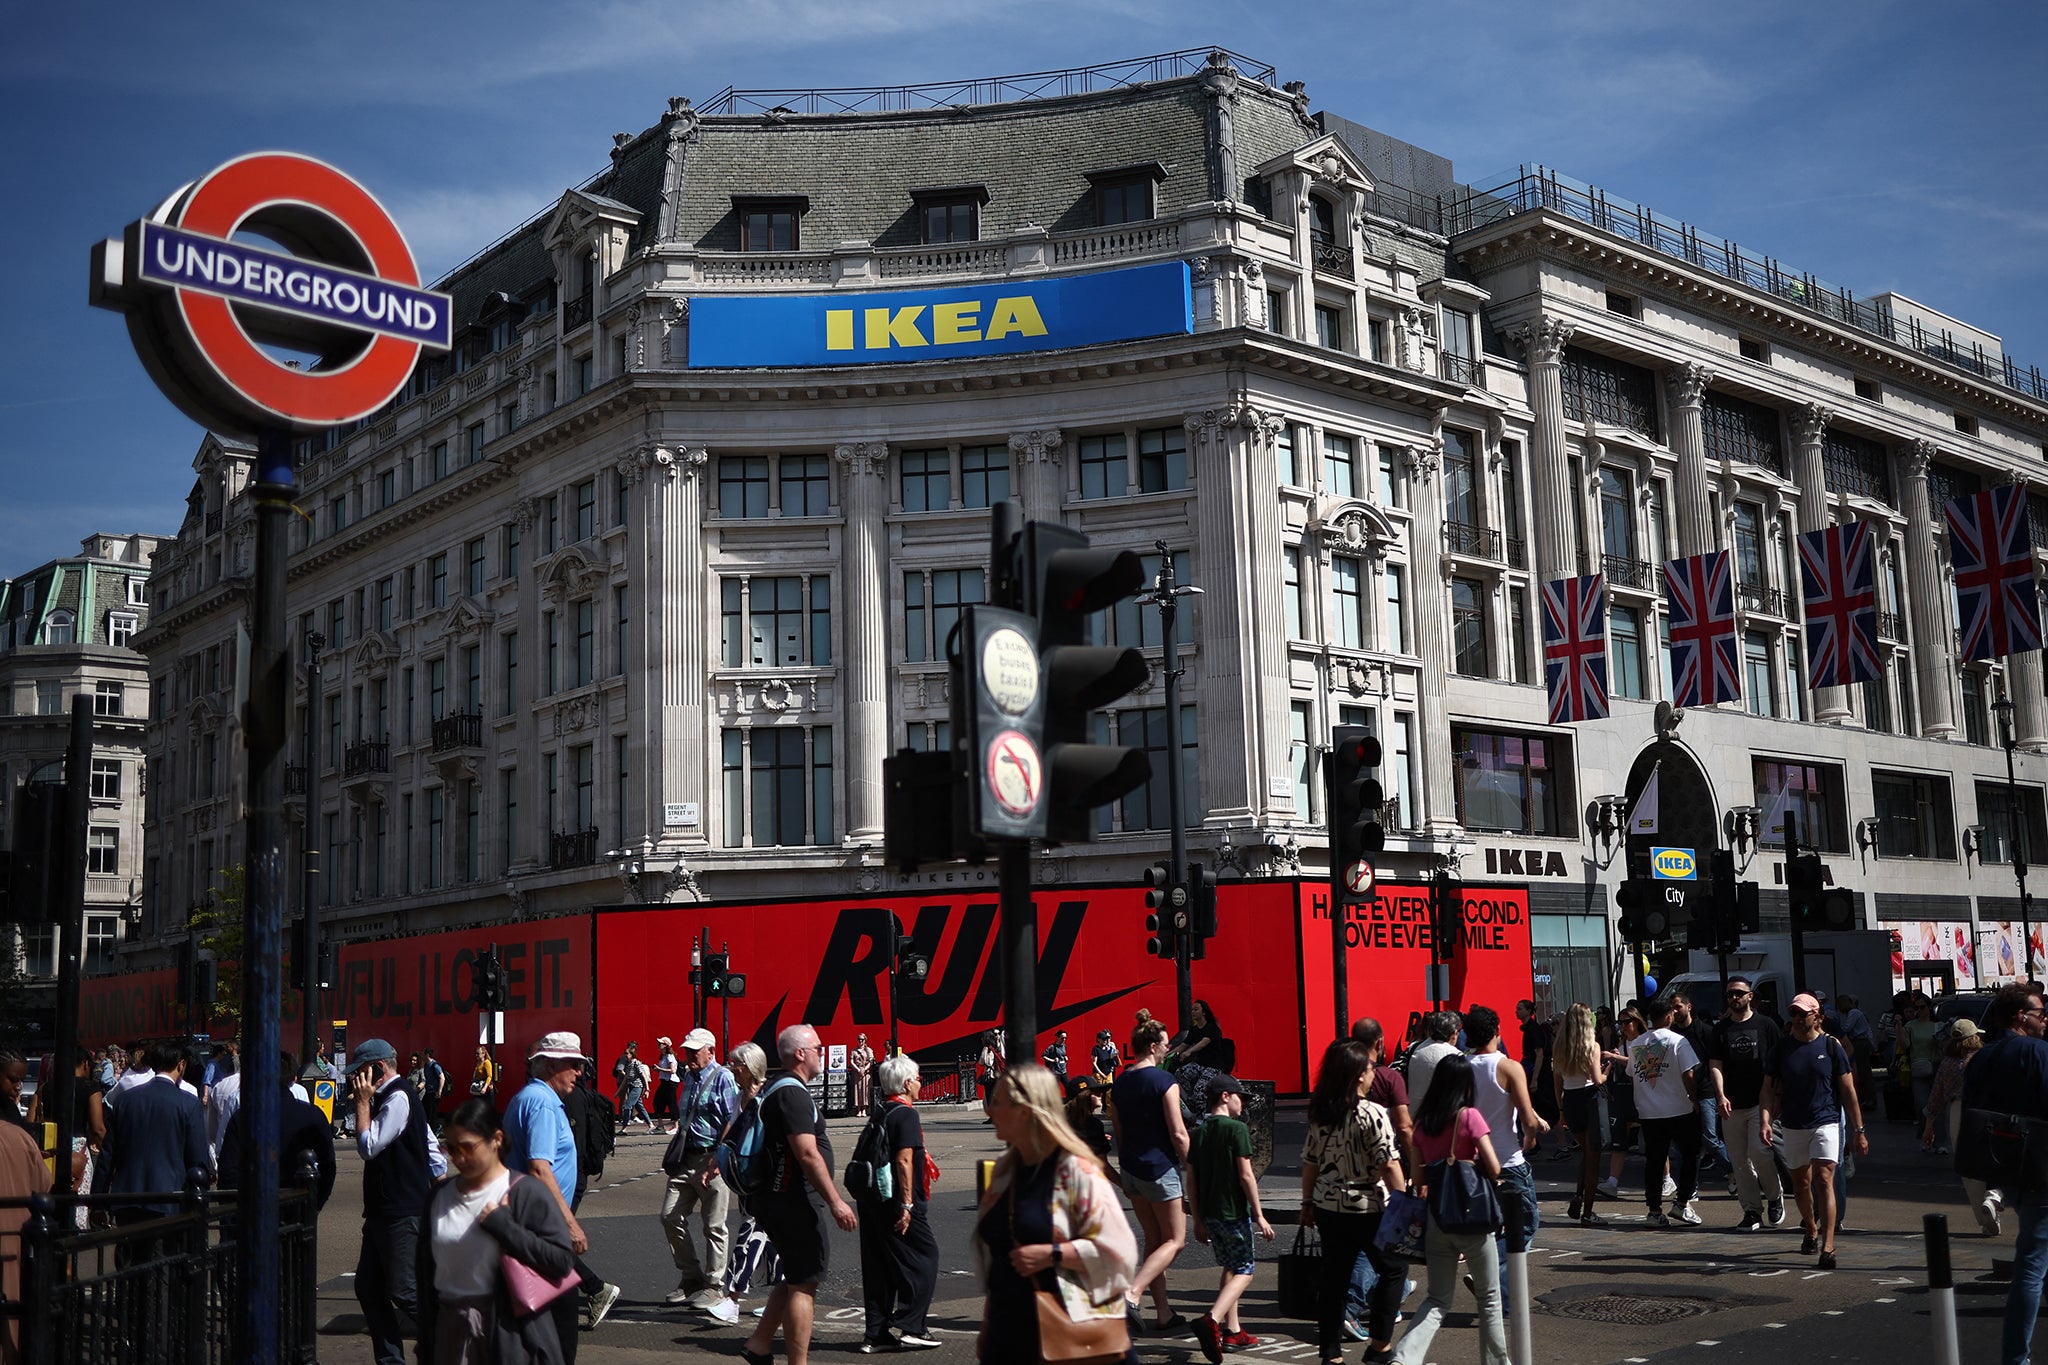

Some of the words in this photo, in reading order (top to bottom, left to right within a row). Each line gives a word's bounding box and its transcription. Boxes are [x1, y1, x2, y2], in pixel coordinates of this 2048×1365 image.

[157, 237, 438, 331] UNDERGROUND
[826, 295, 1049, 351] IKEA
[901, 870, 1001, 884] NIKETOW
[1486, 849, 1568, 877] IKEA
[1658, 857, 1692, 869] IKEA
[1665, 887, 1685, 907] City
[1345, 921, 1388, 948] OVE
[419, 953, 427, 1015] I
[433, 942, 527, 1017] LOE
[533, 937, 573, 1008] IT.
[801, 901, 1090, 1026] RUN
